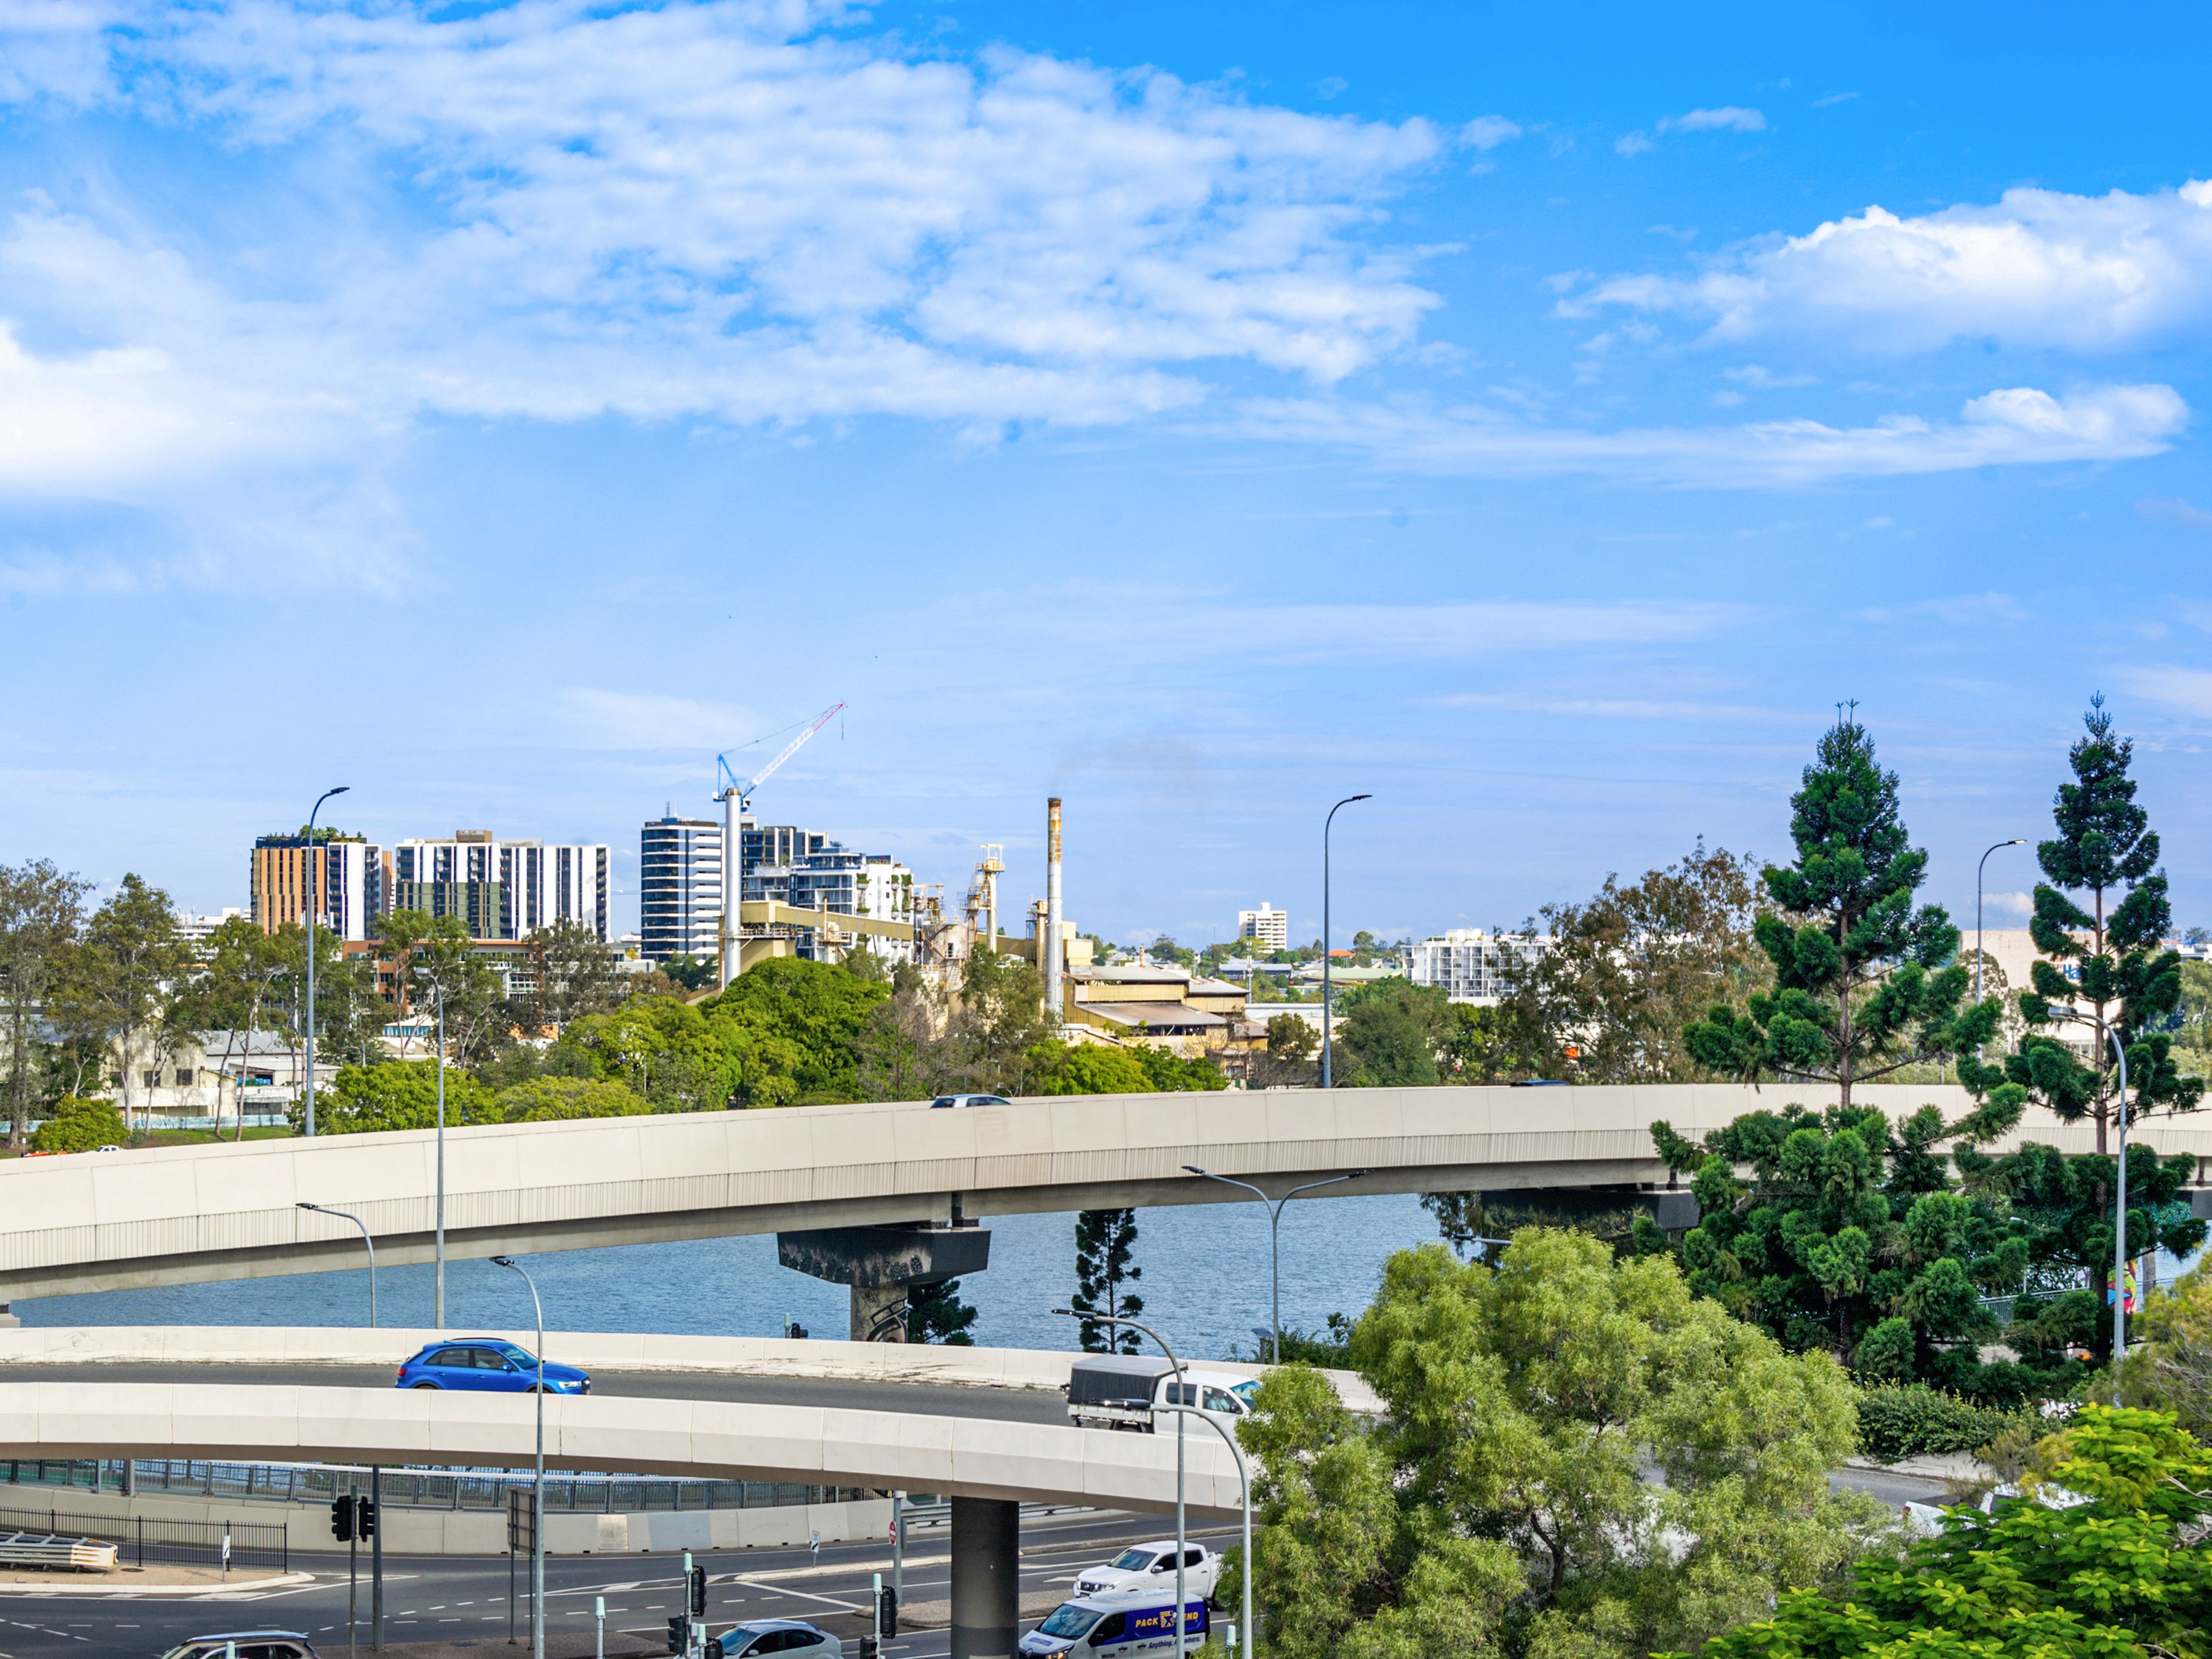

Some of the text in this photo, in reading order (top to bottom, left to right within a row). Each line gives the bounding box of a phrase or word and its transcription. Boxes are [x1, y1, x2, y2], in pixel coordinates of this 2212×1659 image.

[1135, 1617, 1158, 1628] PACK
[1148, 1636, 1200, 1649] Anything. Awhere.
